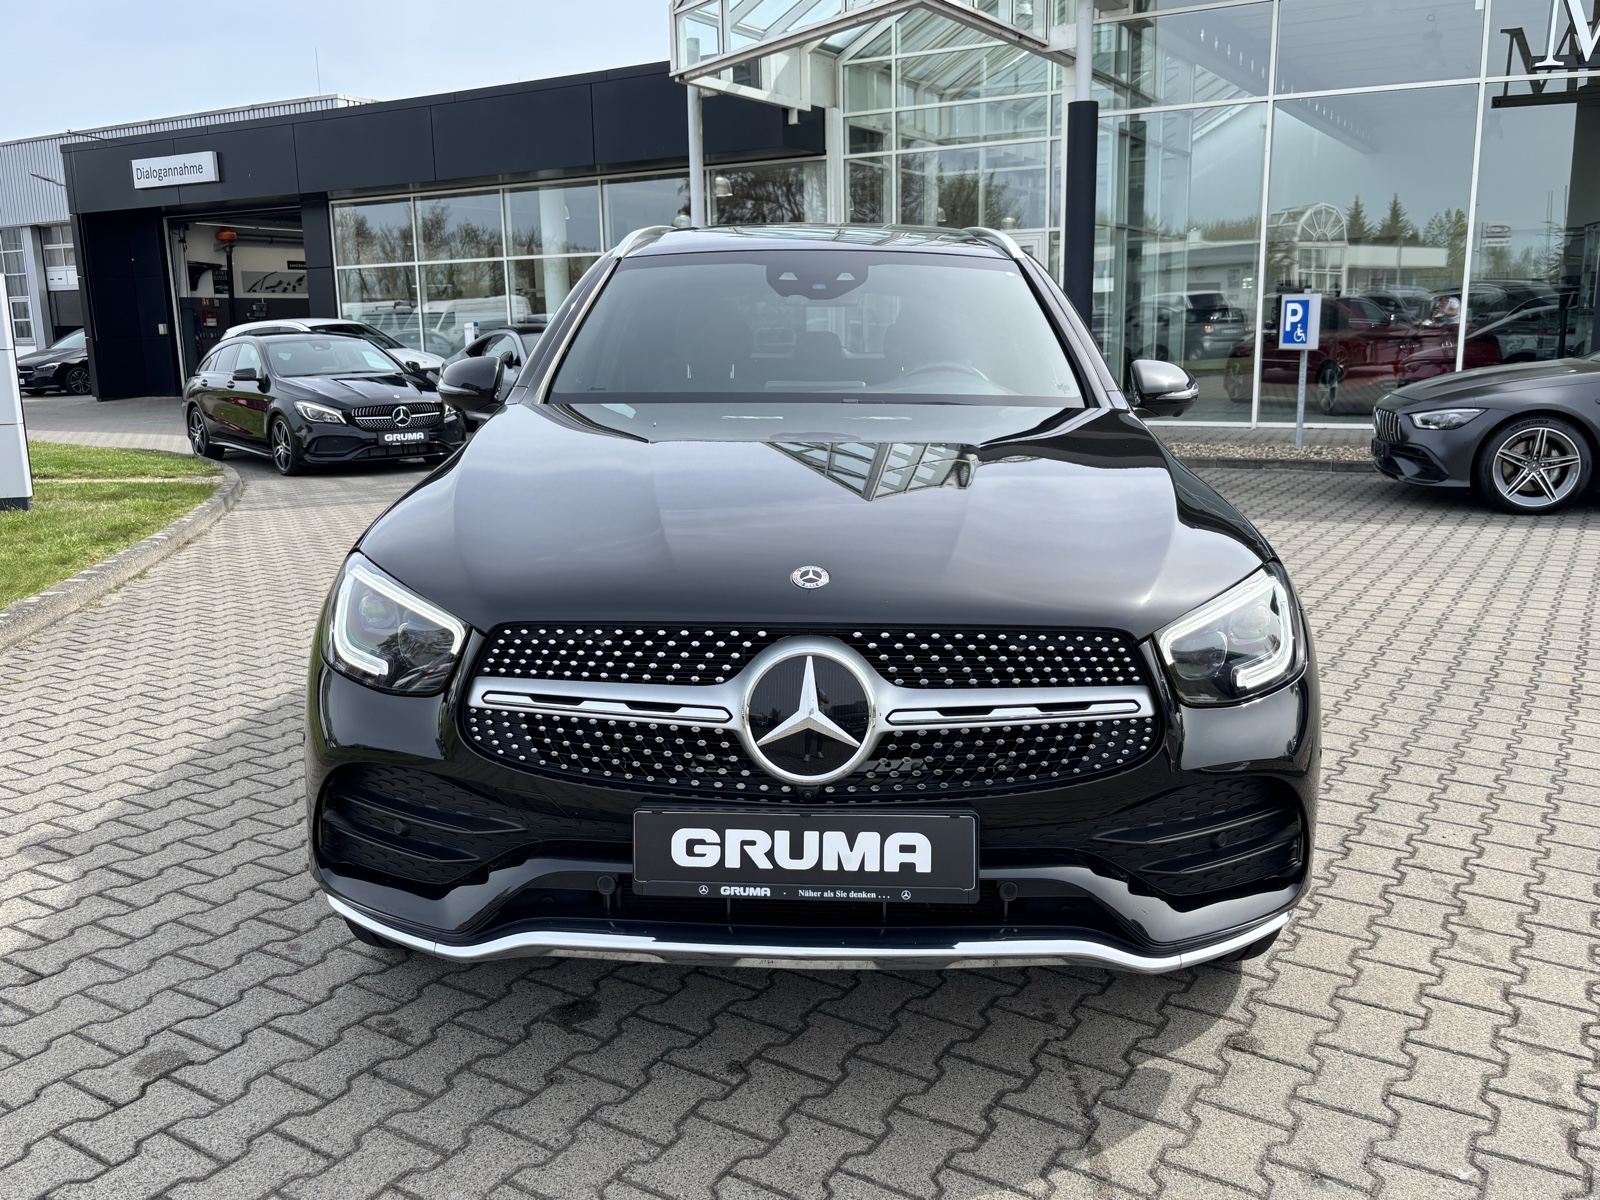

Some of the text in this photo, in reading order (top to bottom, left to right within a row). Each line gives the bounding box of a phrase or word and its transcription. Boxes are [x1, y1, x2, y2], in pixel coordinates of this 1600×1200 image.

[136, 163, 203, 182] Dialogannahme
[1285, 303, 1303, 331] P
[384, 432, 424, 441] GRUMA
[671, 828, 932, 873] GRUMA
[720, 886, 771, 896] GRUMA
[798, 889, 822, 897] Näher
[823, 890, 834, 898] als
[835, 890, 847, 898] Sie
